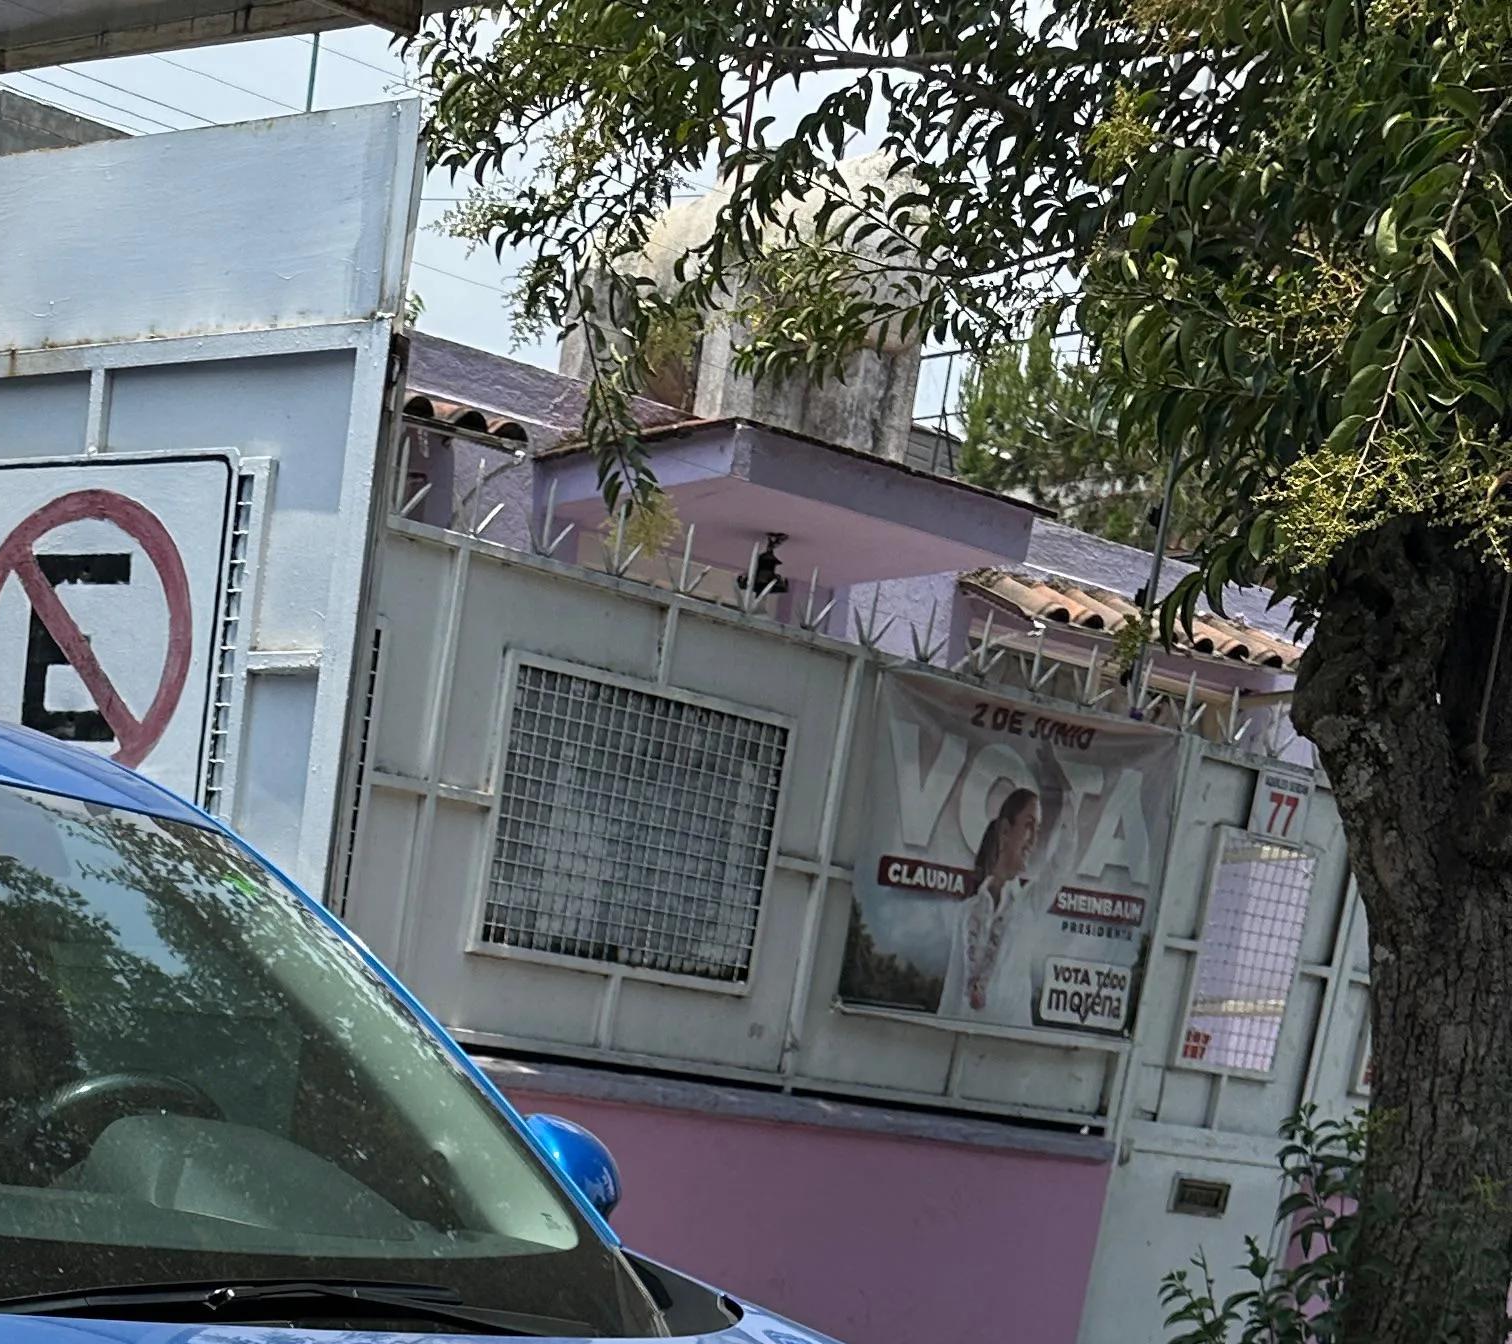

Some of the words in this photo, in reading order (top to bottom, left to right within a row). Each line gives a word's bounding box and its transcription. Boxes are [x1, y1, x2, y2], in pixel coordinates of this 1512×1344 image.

[970, 702, 989, 728] 2
[992, 706, 1027, 736] DE
[1029, 716, 1096, 750] JUNIO
[890, 718, 1149, 887] VOTA
[1267, 791, 1300, 838] 77
[888, 862, 965, 895] CLAUDIA
[1056, 892, 1143, 921] SHEINBAUM
[1053, 964, 1091, 986] VOTA
[1047, 988, 1122, 1023] morena
